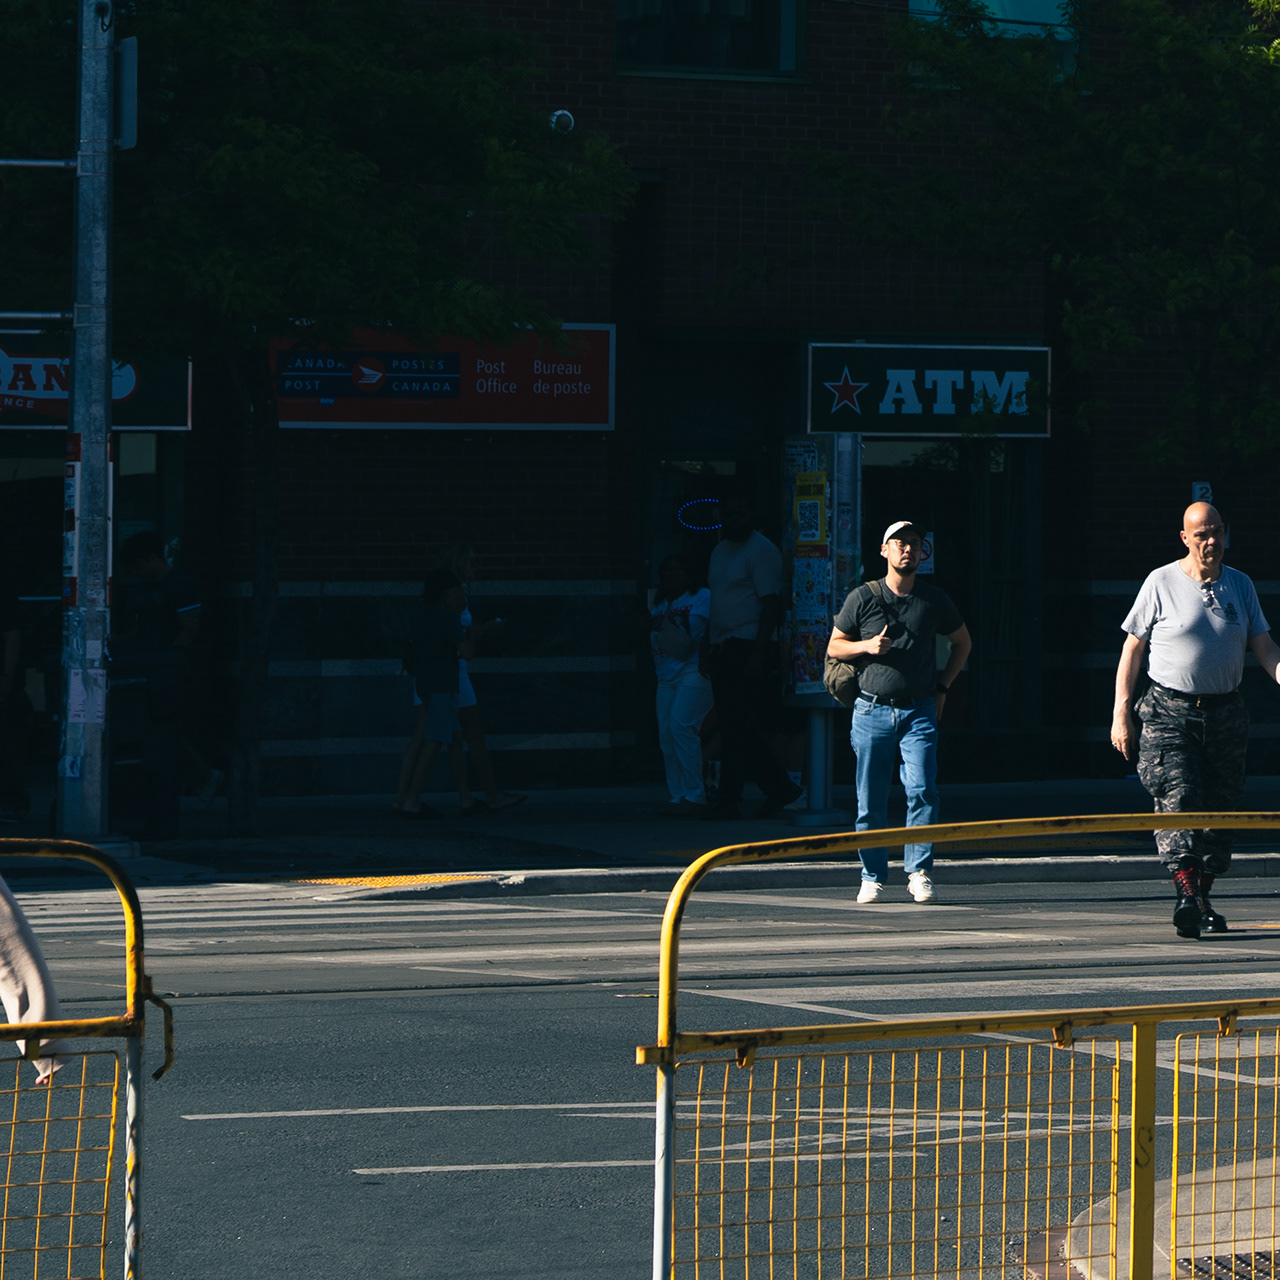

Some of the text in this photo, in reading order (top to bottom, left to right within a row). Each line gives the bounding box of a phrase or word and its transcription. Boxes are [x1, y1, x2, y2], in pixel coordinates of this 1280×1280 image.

[476, 360, 506, 375] Post
[533, 360, 582, 375] Bureau
[285, 380, 452, 392] POST CANADA
[476, 378, 517, 395] Office
[533, 378, 592, 398] de poste
[879, 369, 1030, 415] ATM
